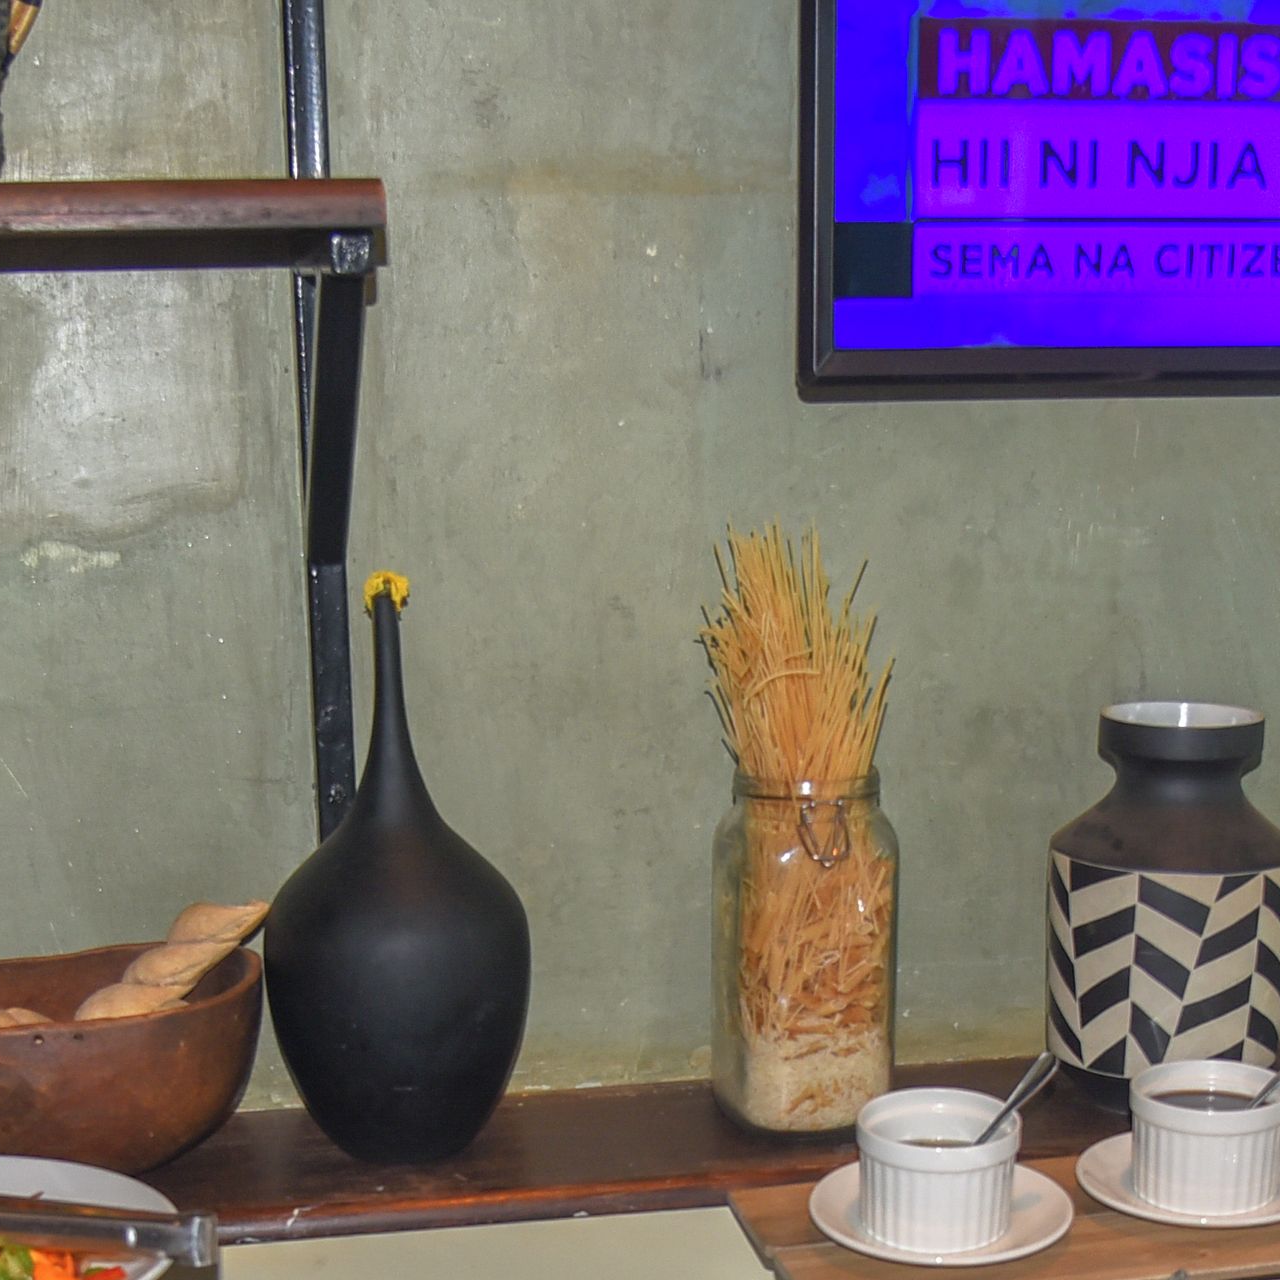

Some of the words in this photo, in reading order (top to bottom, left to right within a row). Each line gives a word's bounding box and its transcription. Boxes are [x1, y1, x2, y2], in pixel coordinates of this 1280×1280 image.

[931, 138, 1010, 190] HII
[1040, 139, 1099, 190] NI
[1126, 140, 1268, 190] NJIA
[929, 242, 1055, 279] SEMA
[1073, 243, 1136, 279] NA
